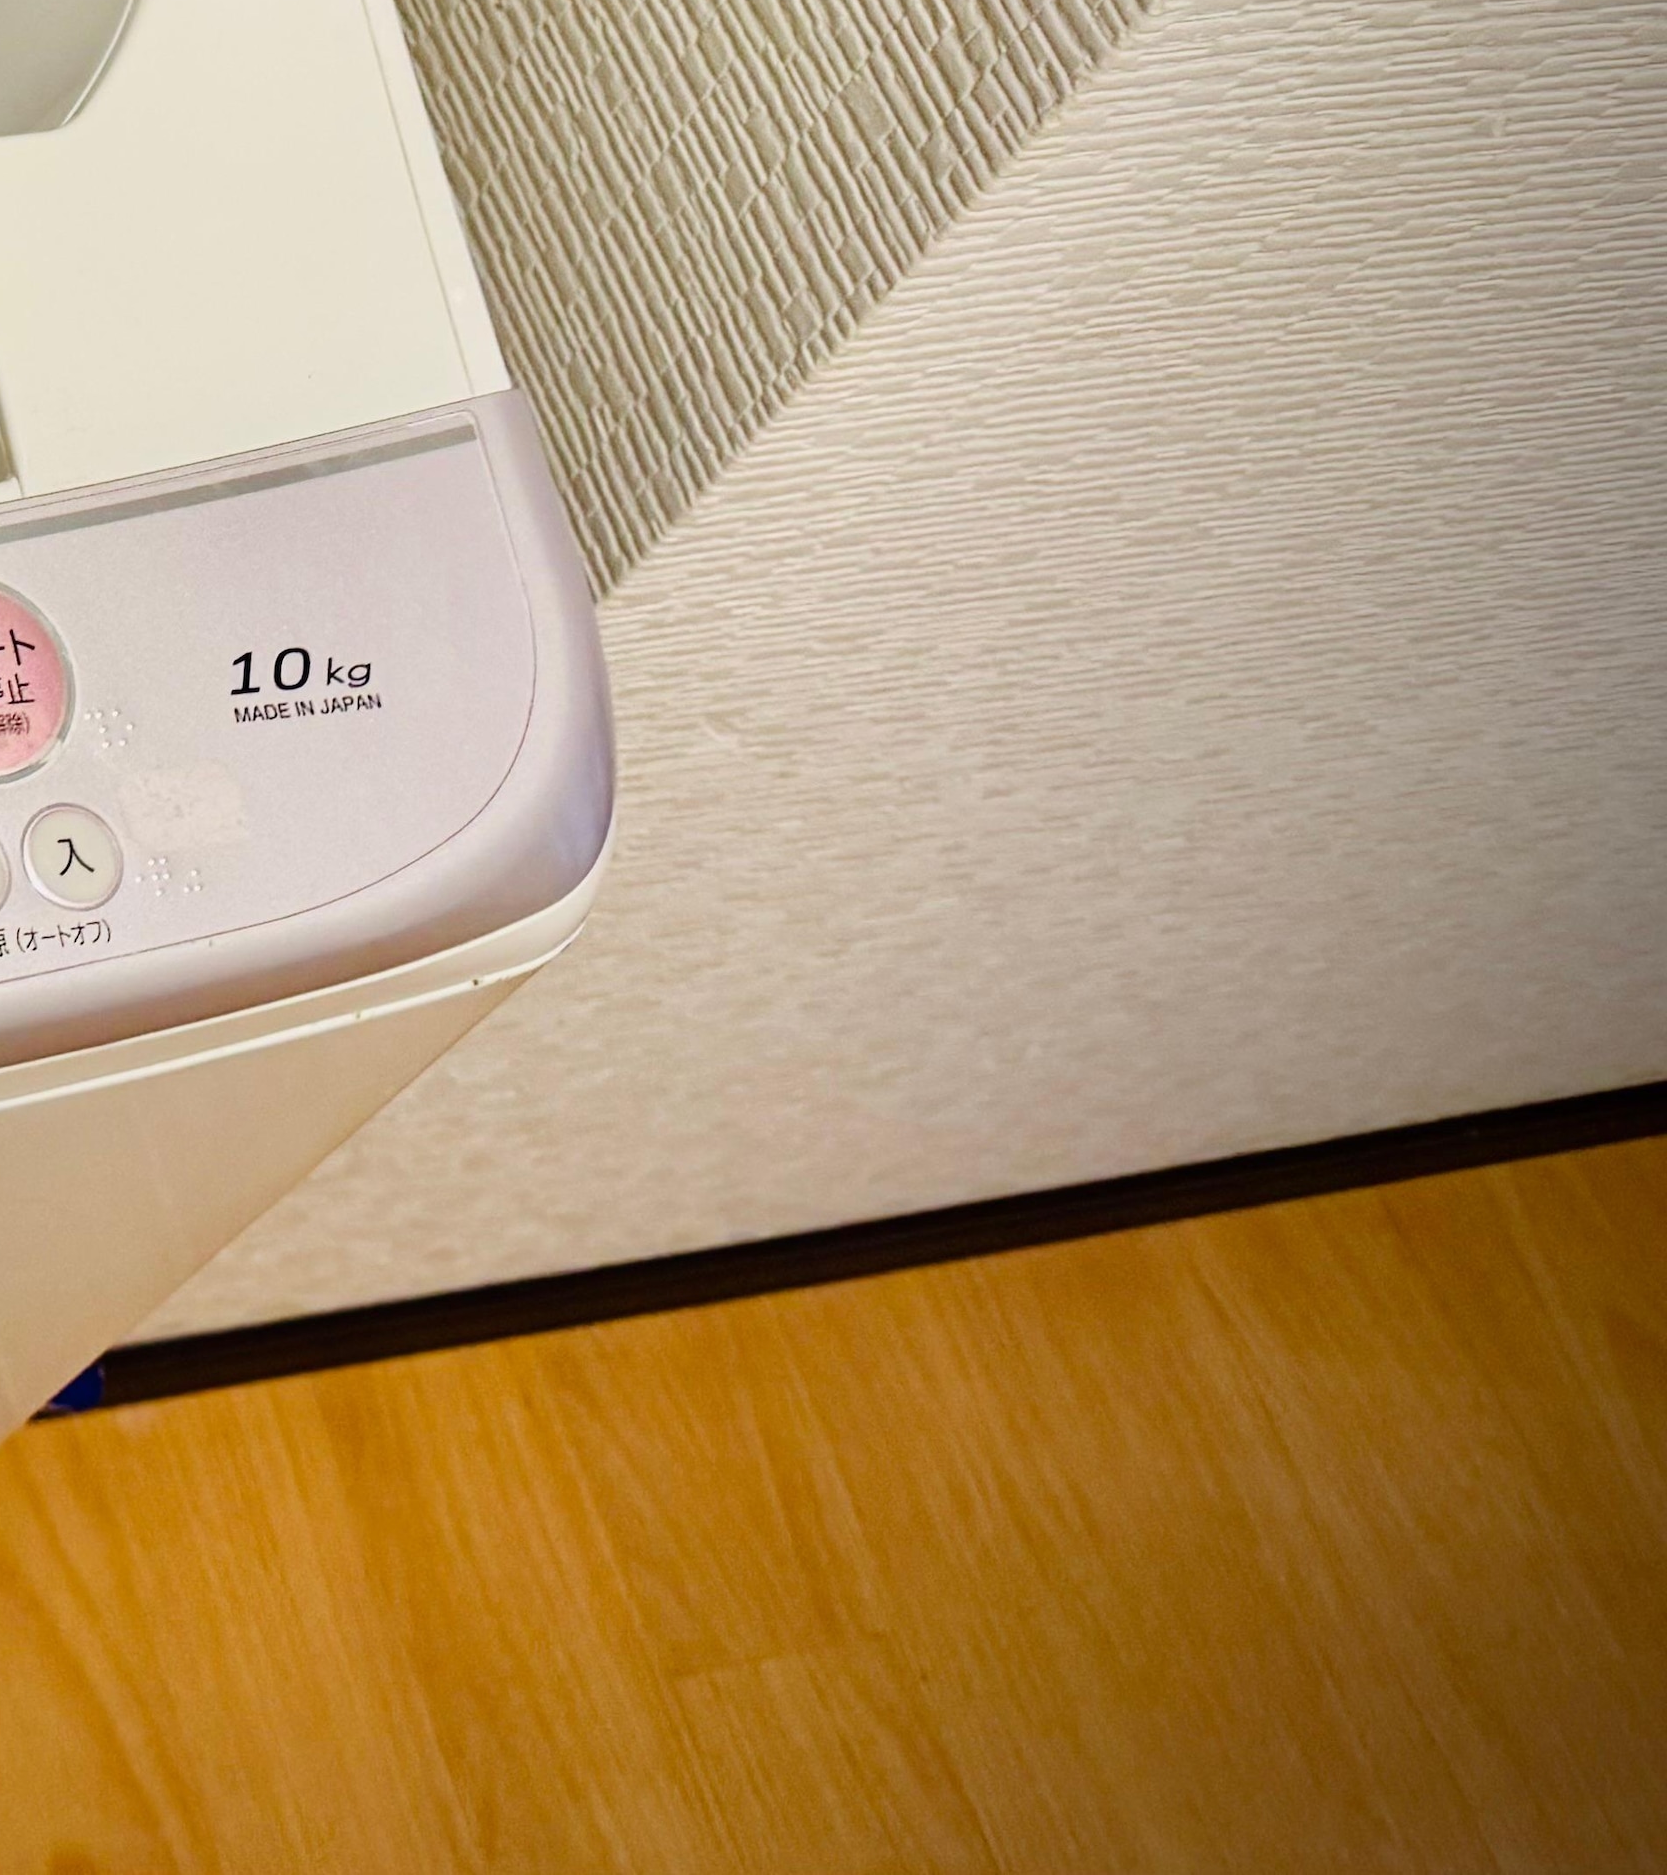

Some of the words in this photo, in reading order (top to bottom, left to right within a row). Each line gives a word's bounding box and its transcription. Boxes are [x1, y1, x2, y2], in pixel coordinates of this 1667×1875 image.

[230, 647, 311, 695] 10
[326, 656, 371, 688] kg
[233, 702, 291, 723] MADE
[295, 699, 315, 717] IN
[320, 692, 383, 715] JAPAN
[57, 838, 95, 877] 入
[16, 918, 112, 954] (オートオフ)
